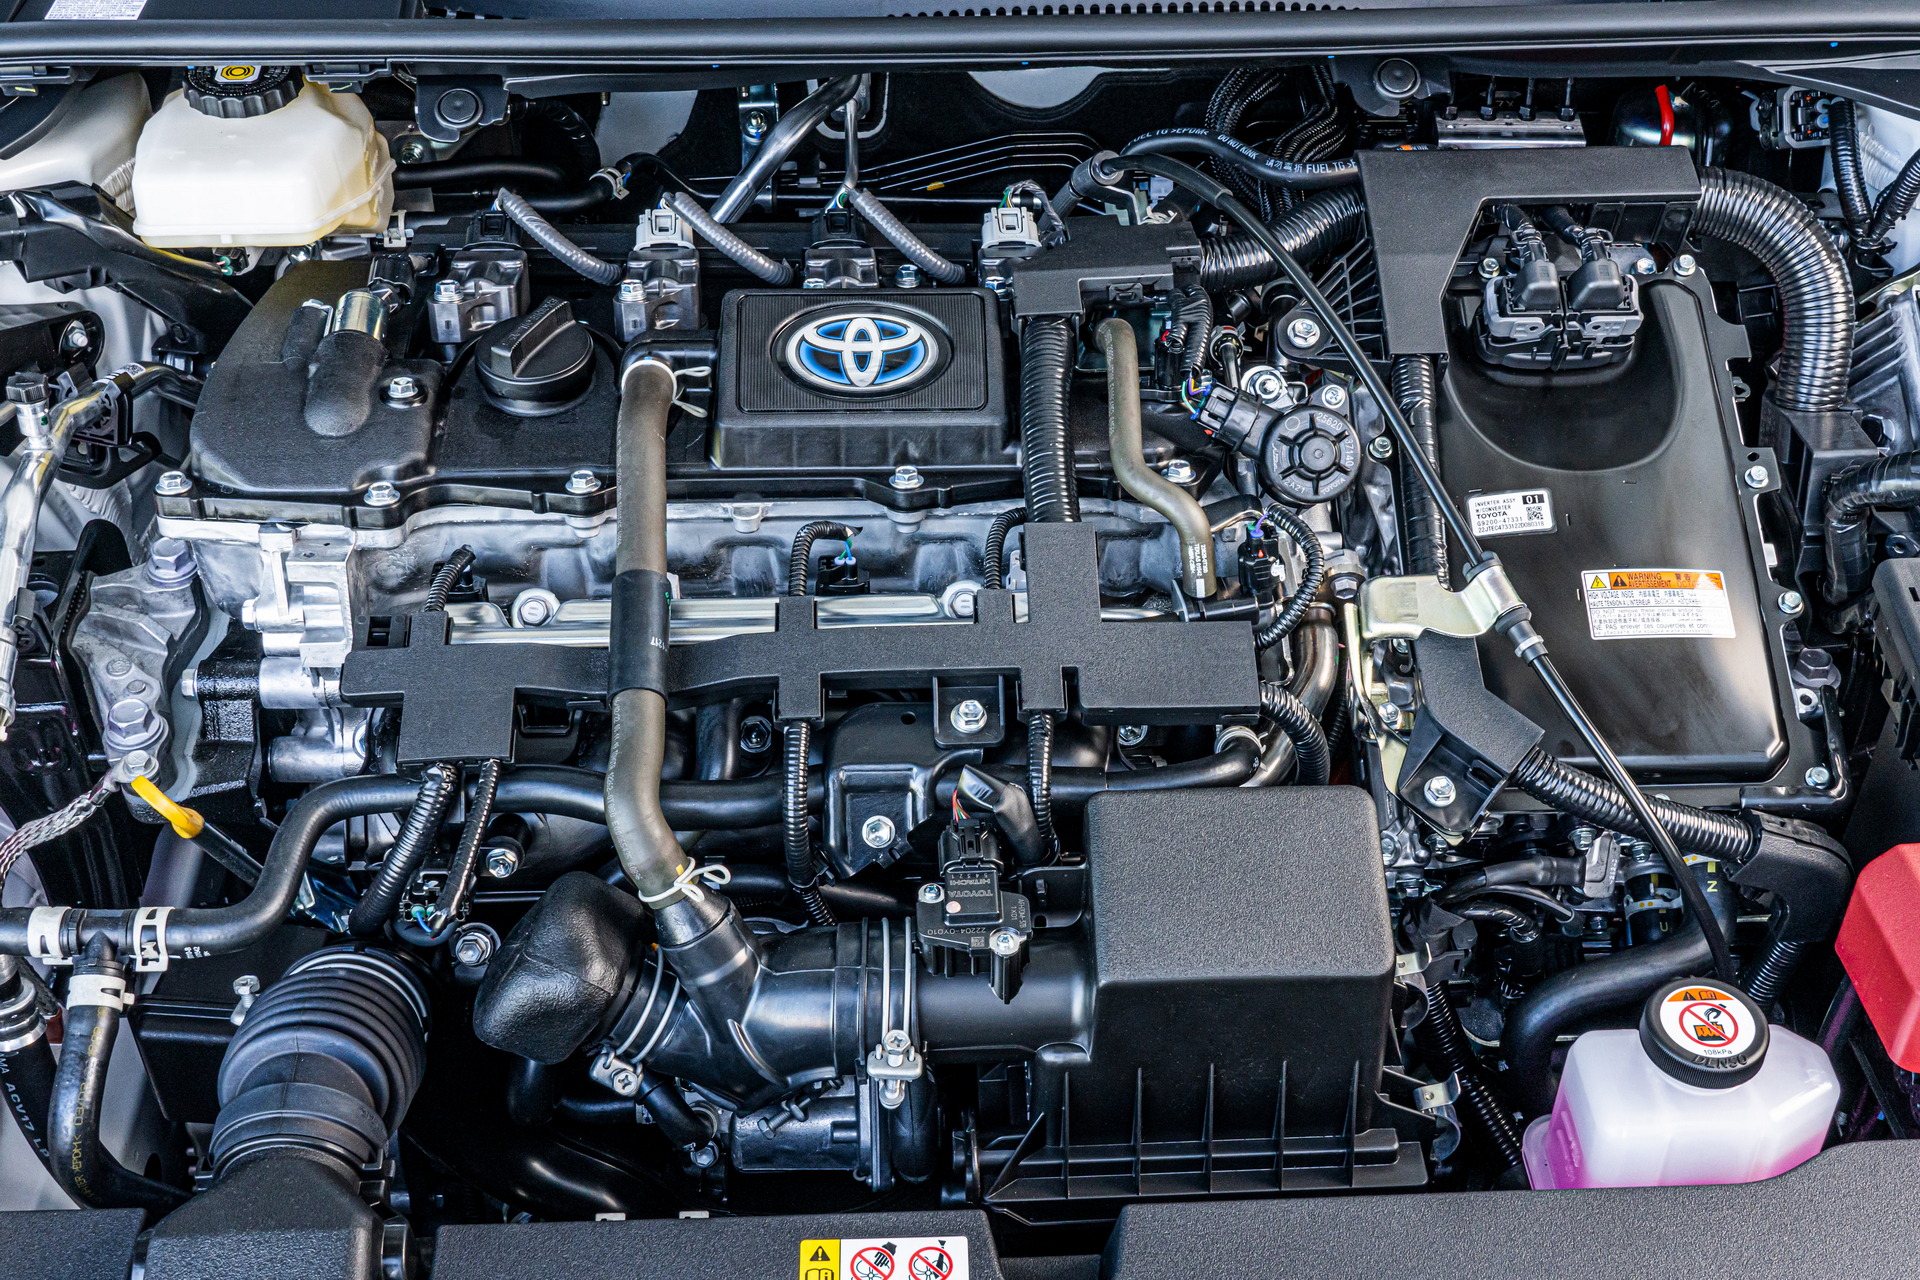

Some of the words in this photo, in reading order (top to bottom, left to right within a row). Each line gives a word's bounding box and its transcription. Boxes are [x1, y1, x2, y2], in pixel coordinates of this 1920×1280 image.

[1239, 145, 1259, 160] KINK
[1306, 162, 1329, 174] FUEL
[1332, 161, 1345, 173] TG
[1316, 412, 1343, 431] 25620
[1345, 438, 1354, 467] 37140
[1284, 479, 1306, 494] 2A21
[1320, 477, 1346, 495] TOYOTA
[1525, 494, 1540, 505] 01
[1475, 504, 1512, 513] W/CONVERTER
[1476, 511, 1508, 520] TOYOTA
[1477, 516, 1523, 527] G9200-47331
[1628, 580, 1671, 588] AVERTISSEMENT
[1600, 591, 1619, 599] VOLTAGE
[1621, 590, 1635, 598] INSIDE
[947, 889, 993, 898] TOYOTA
[927, 927, 986, 936] 22204-0Y010
[1693, 1053, 1748, 1069] DENSO
[6, 1082, 35, 1132] ACV17
